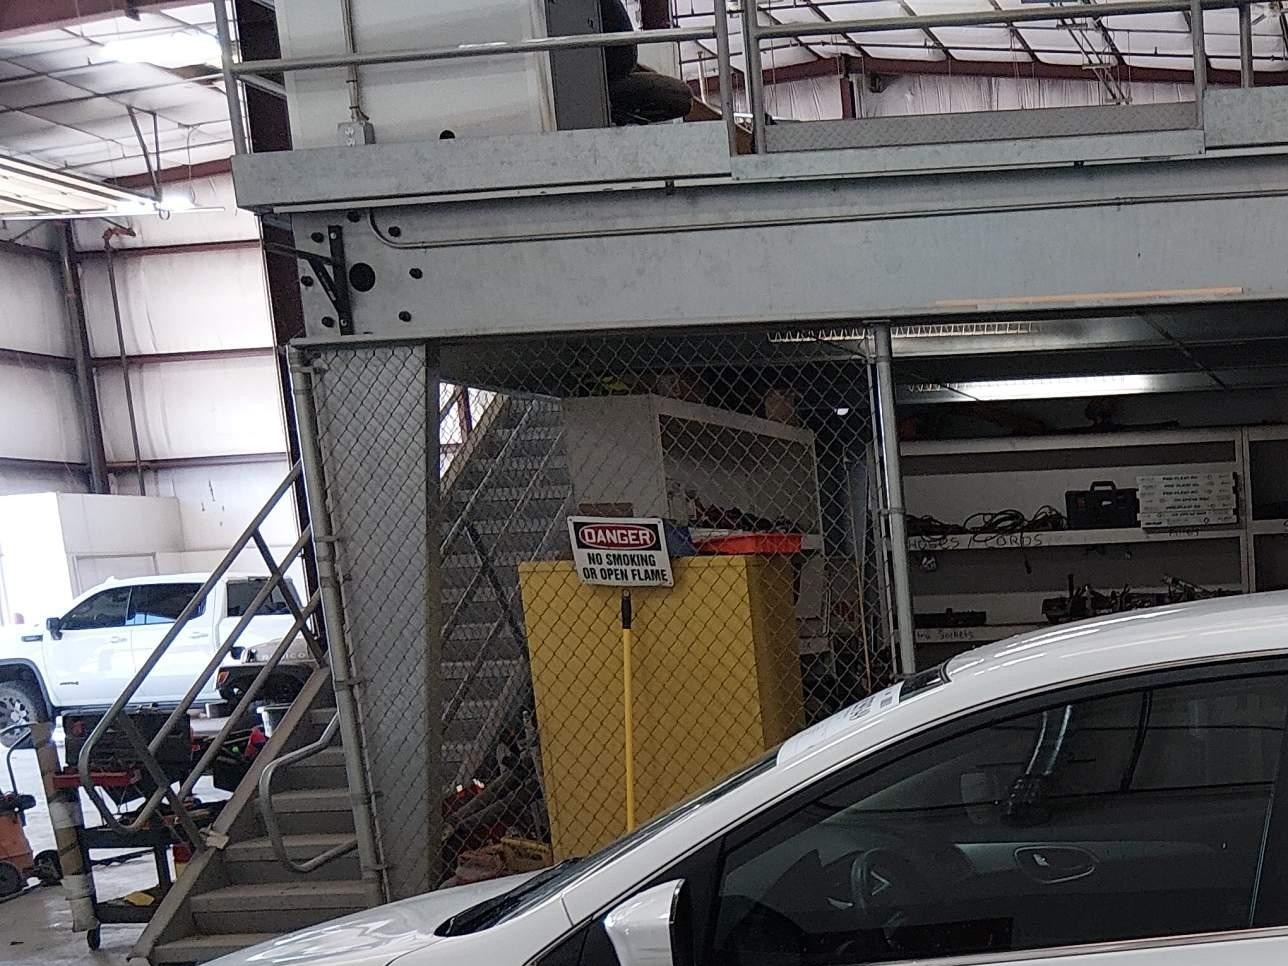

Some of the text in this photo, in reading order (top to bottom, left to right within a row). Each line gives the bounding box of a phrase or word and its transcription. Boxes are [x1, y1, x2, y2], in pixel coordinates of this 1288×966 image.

[584, 528, 650, 545] DANGER
[587, 553, 656, 567] NO SMOKING
[583, 567, 668, 582] OR OPEN FLAME
